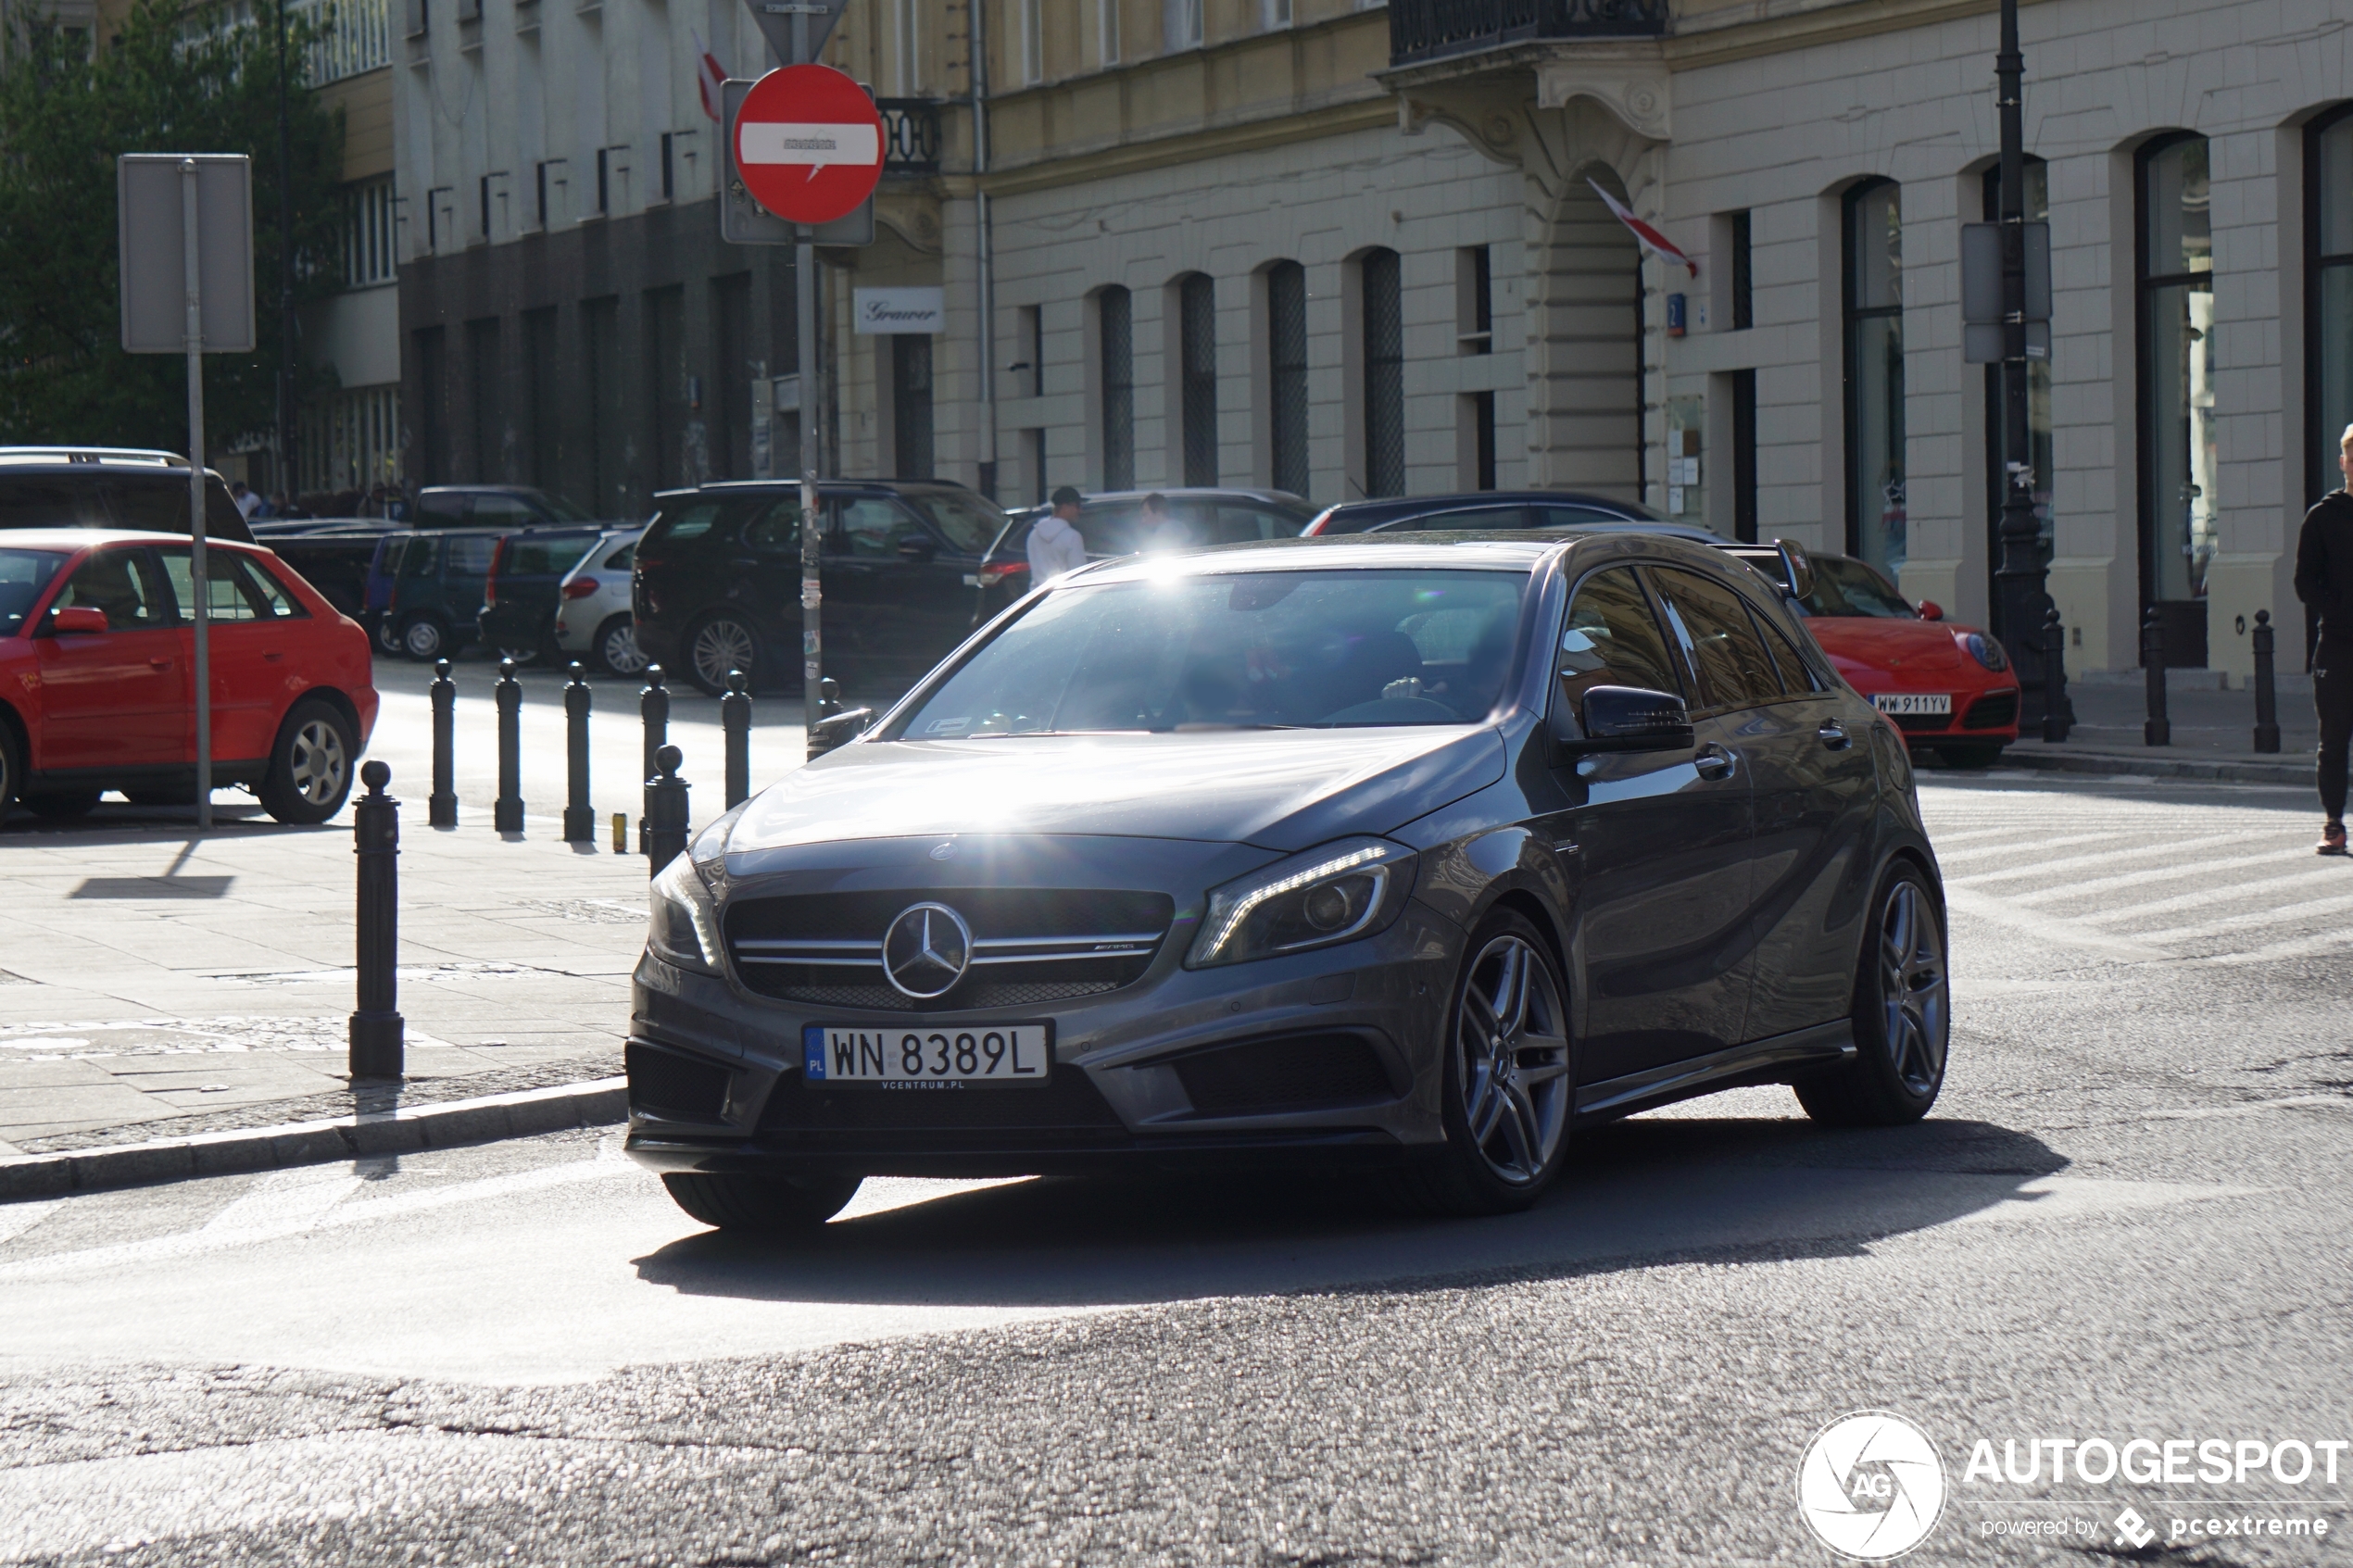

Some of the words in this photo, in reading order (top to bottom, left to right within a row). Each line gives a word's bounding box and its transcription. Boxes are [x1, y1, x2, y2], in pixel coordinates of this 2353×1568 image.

[1878, 696, 1898, 712] WW
[1903, 696, 1947, 712] 911YV
[832, 1033, 885, 1076] WN
[900, 1031, 1036, 1075] 8389L
[809, 1060, 824, 1073] PL
[881, 1081, 965, 1090] VCENTRUM.PL
